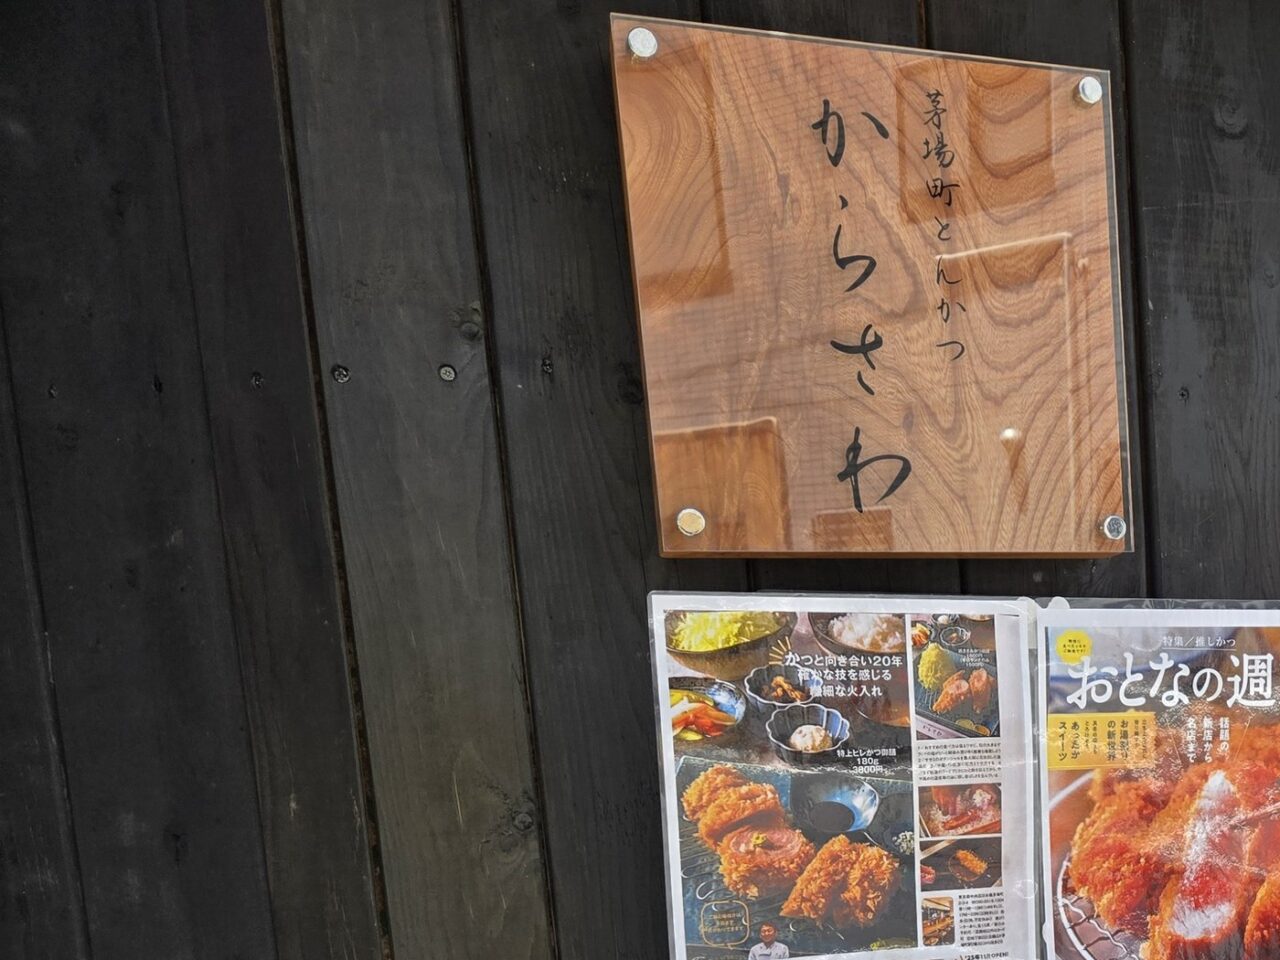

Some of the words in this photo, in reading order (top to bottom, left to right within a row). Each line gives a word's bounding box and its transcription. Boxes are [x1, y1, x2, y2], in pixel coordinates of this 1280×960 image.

[922, 90, 967, 362] 茅場町とんかつ
[811, 98, 912, 514] からさわ
[784, 651, 904, 668] かつと向き合い20年
[797, 668, 892, 682] 確かな技を感じる
[836, 748, 897, 758] 特上ヒレかつ御膳
[1058, 721, 1068, 762] スイーツ
[1071, 721, 1080, 760] あったか
